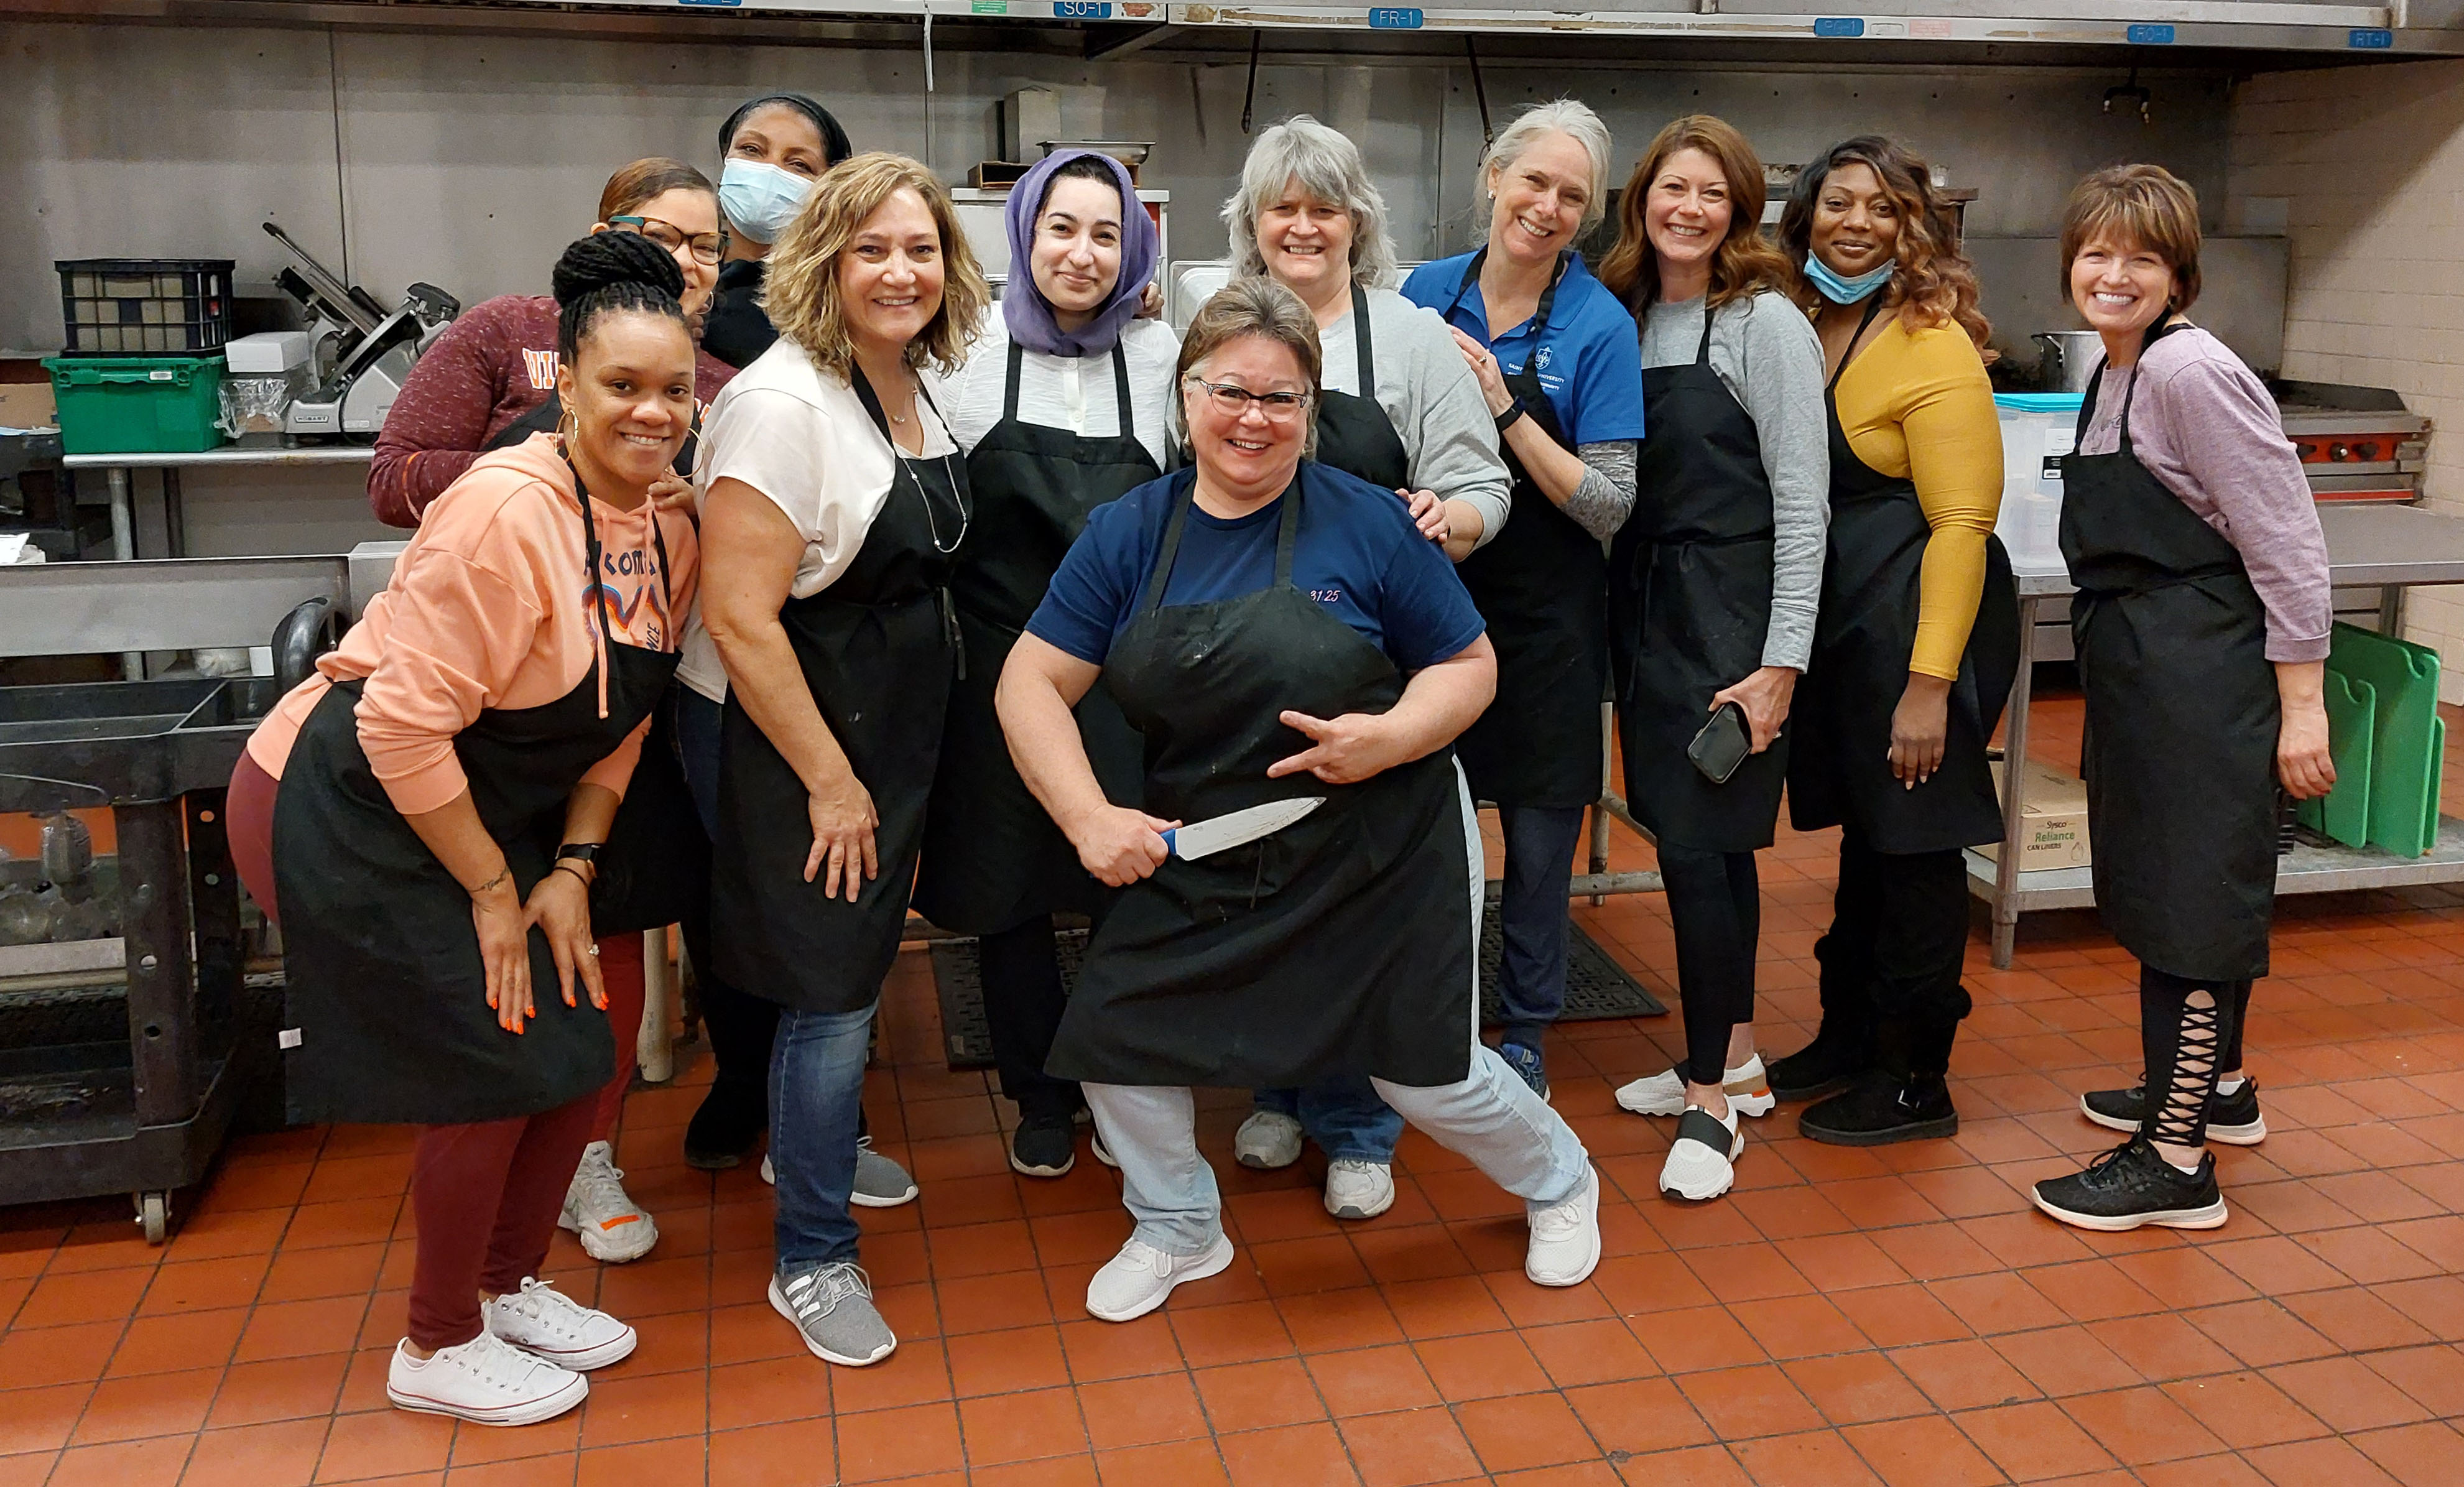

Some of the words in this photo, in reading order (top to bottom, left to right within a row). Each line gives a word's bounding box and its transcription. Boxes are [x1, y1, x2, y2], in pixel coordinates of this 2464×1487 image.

[1064, 2, 1101, 16] SO-1
[1379, 11, 1413, 25] FR-1
[2046, 820, 2067, 830] Sysco
[2035, 831, 2075, 842] Reliance
